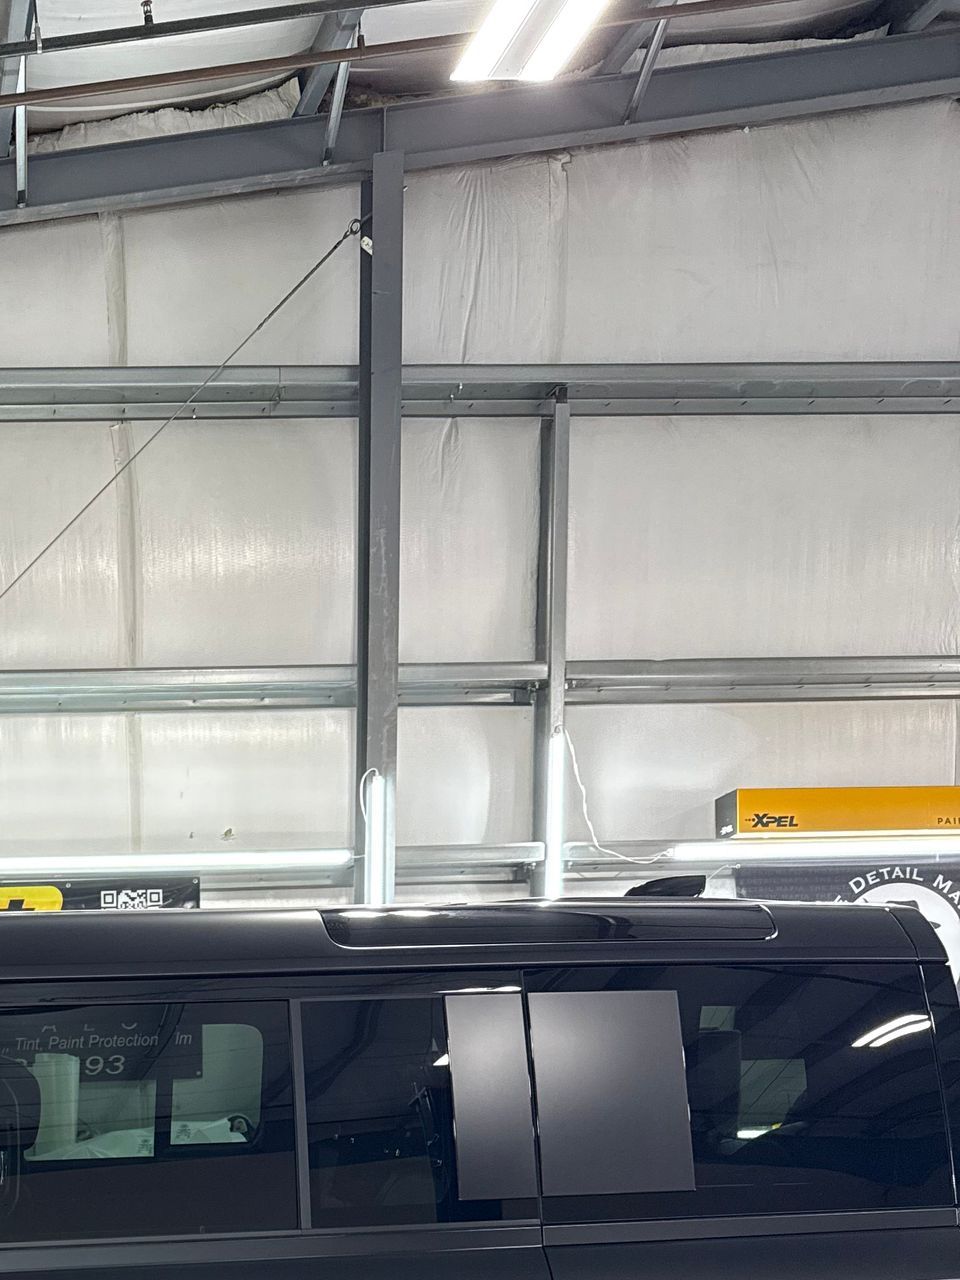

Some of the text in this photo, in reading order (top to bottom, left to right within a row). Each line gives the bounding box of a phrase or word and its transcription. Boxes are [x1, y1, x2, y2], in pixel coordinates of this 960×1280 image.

[751, 813, 960, 828] XPEL PAI
[848, 867, 924, 894] DETAIL
[932, 873, 960, 905] MA
[48, 1035, 85, 1050] Paint
[89, 1033, 159, 1049] Protection
